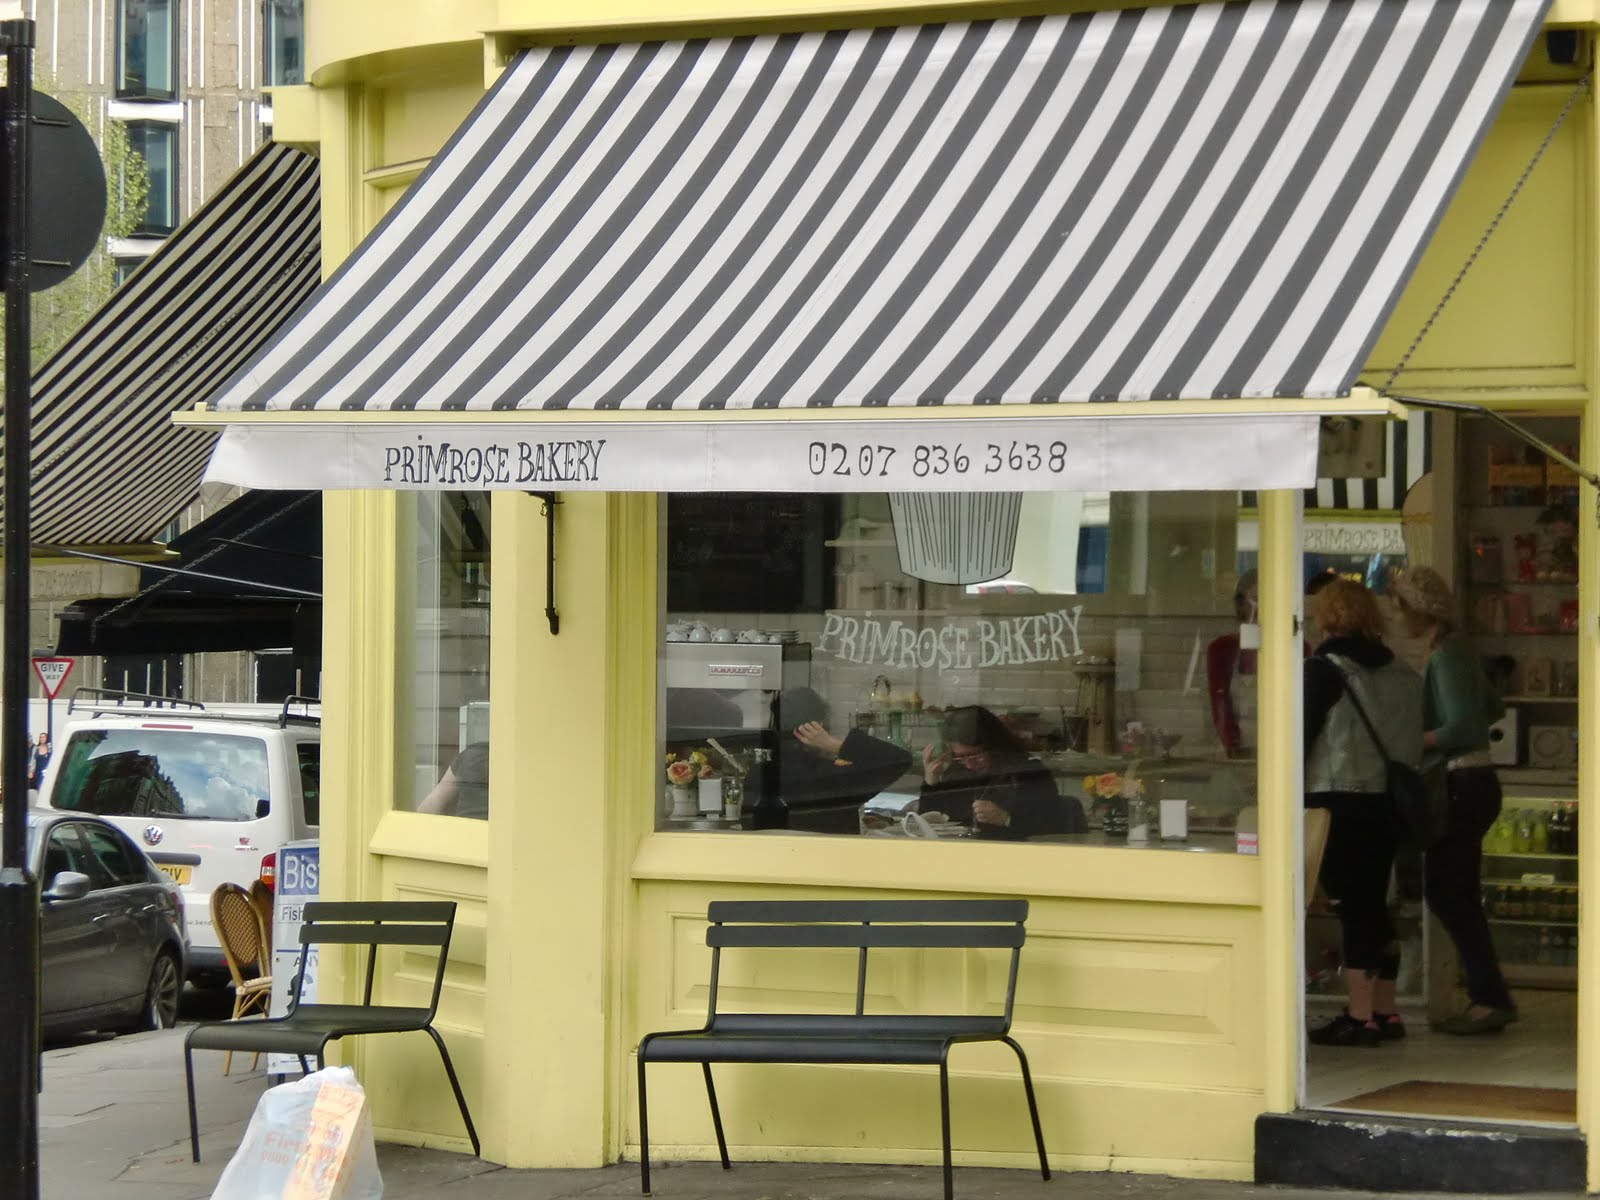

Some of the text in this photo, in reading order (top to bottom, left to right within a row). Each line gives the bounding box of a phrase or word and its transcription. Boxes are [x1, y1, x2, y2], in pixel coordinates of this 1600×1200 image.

[384, 435, 606, 487] PRIMROSE BAKERY
[809, 441, 1067, 477] 0207 836 3638
[814, 605, 1084, 677] PRIMROSE BAKERY
[40, 663, 64, 673] GIVE
[283, 855, 320, 889] Bis
